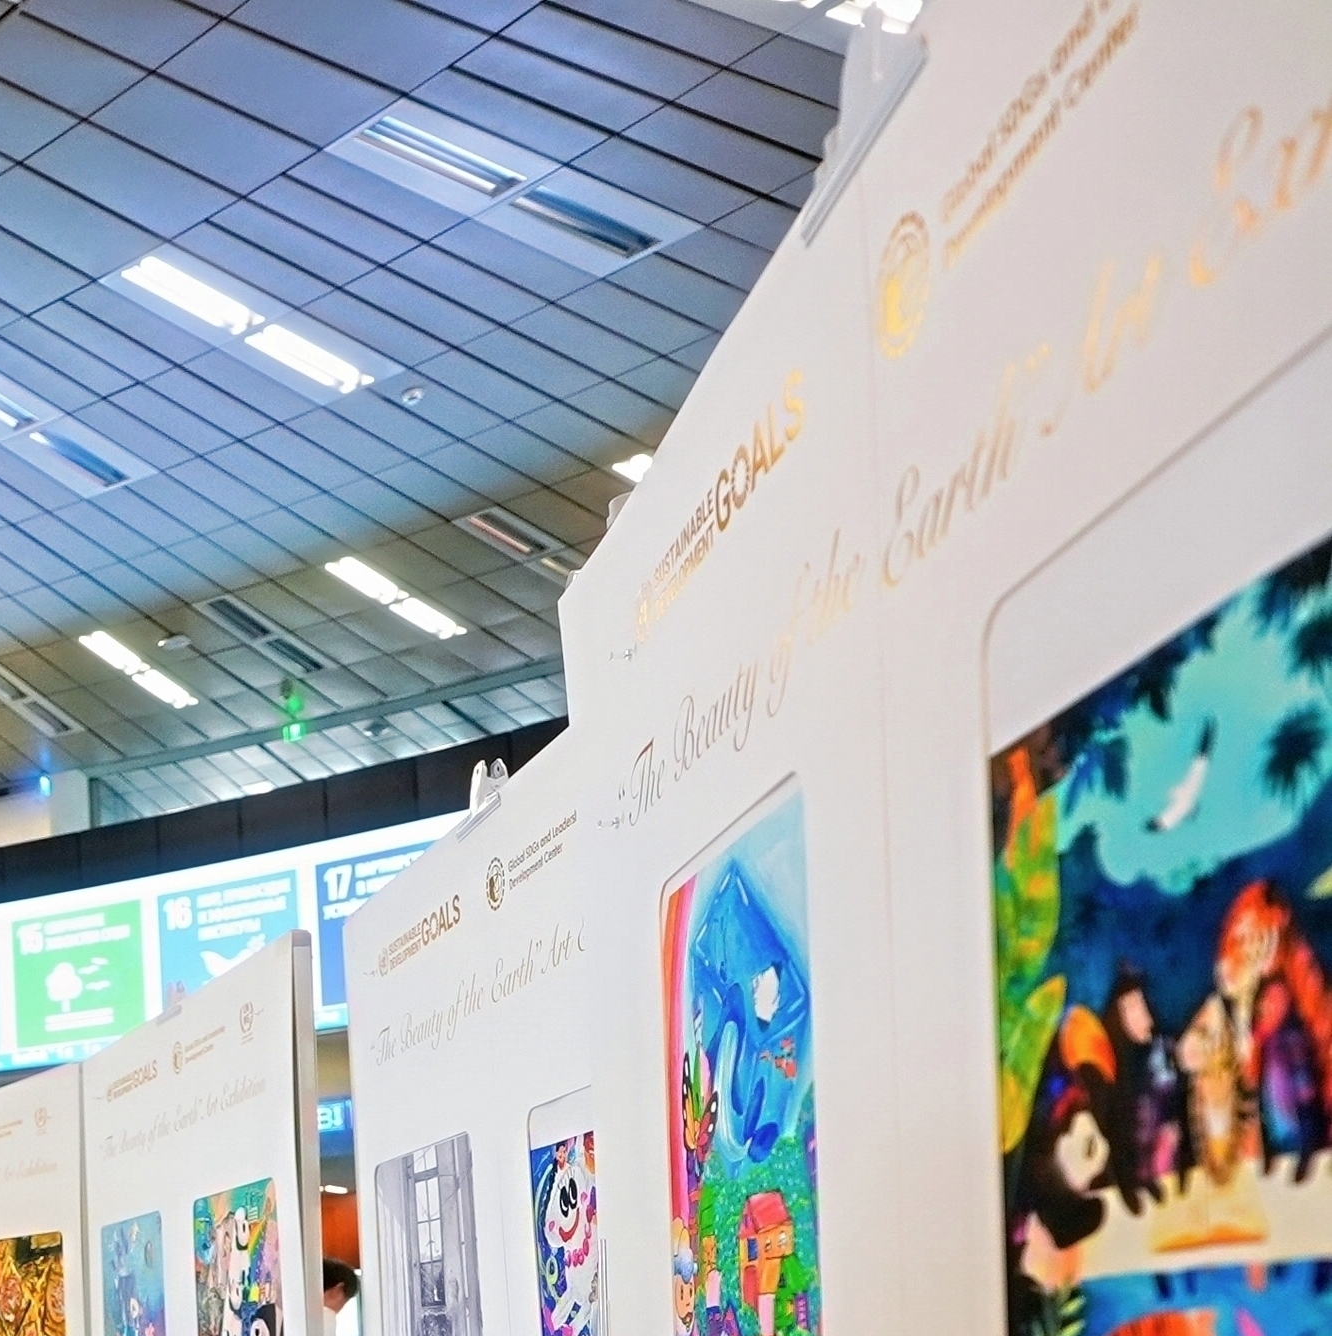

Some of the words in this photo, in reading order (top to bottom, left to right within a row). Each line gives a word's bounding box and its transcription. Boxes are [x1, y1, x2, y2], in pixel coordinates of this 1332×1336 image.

[715, 368, 805, 532] GOALS
[653, 488, 714, 586] SUSTAINABLE
[673, 659, 759, 782] Beauty
[552, 809, 577, 838] Leaders
[323, 864, 353, 902] 17
[163, 896, 194, 931] 16
[421, 894, 461, 947] GOALS
[17, 922, 45, 955] 15
[388, 922, 421, 955] SUSTAINABLE
[389, 939, 422, 970] DEVELOPMENT
[400, 1009, 445, 1051] Beauty
[540, 922, 573, 975] Art
